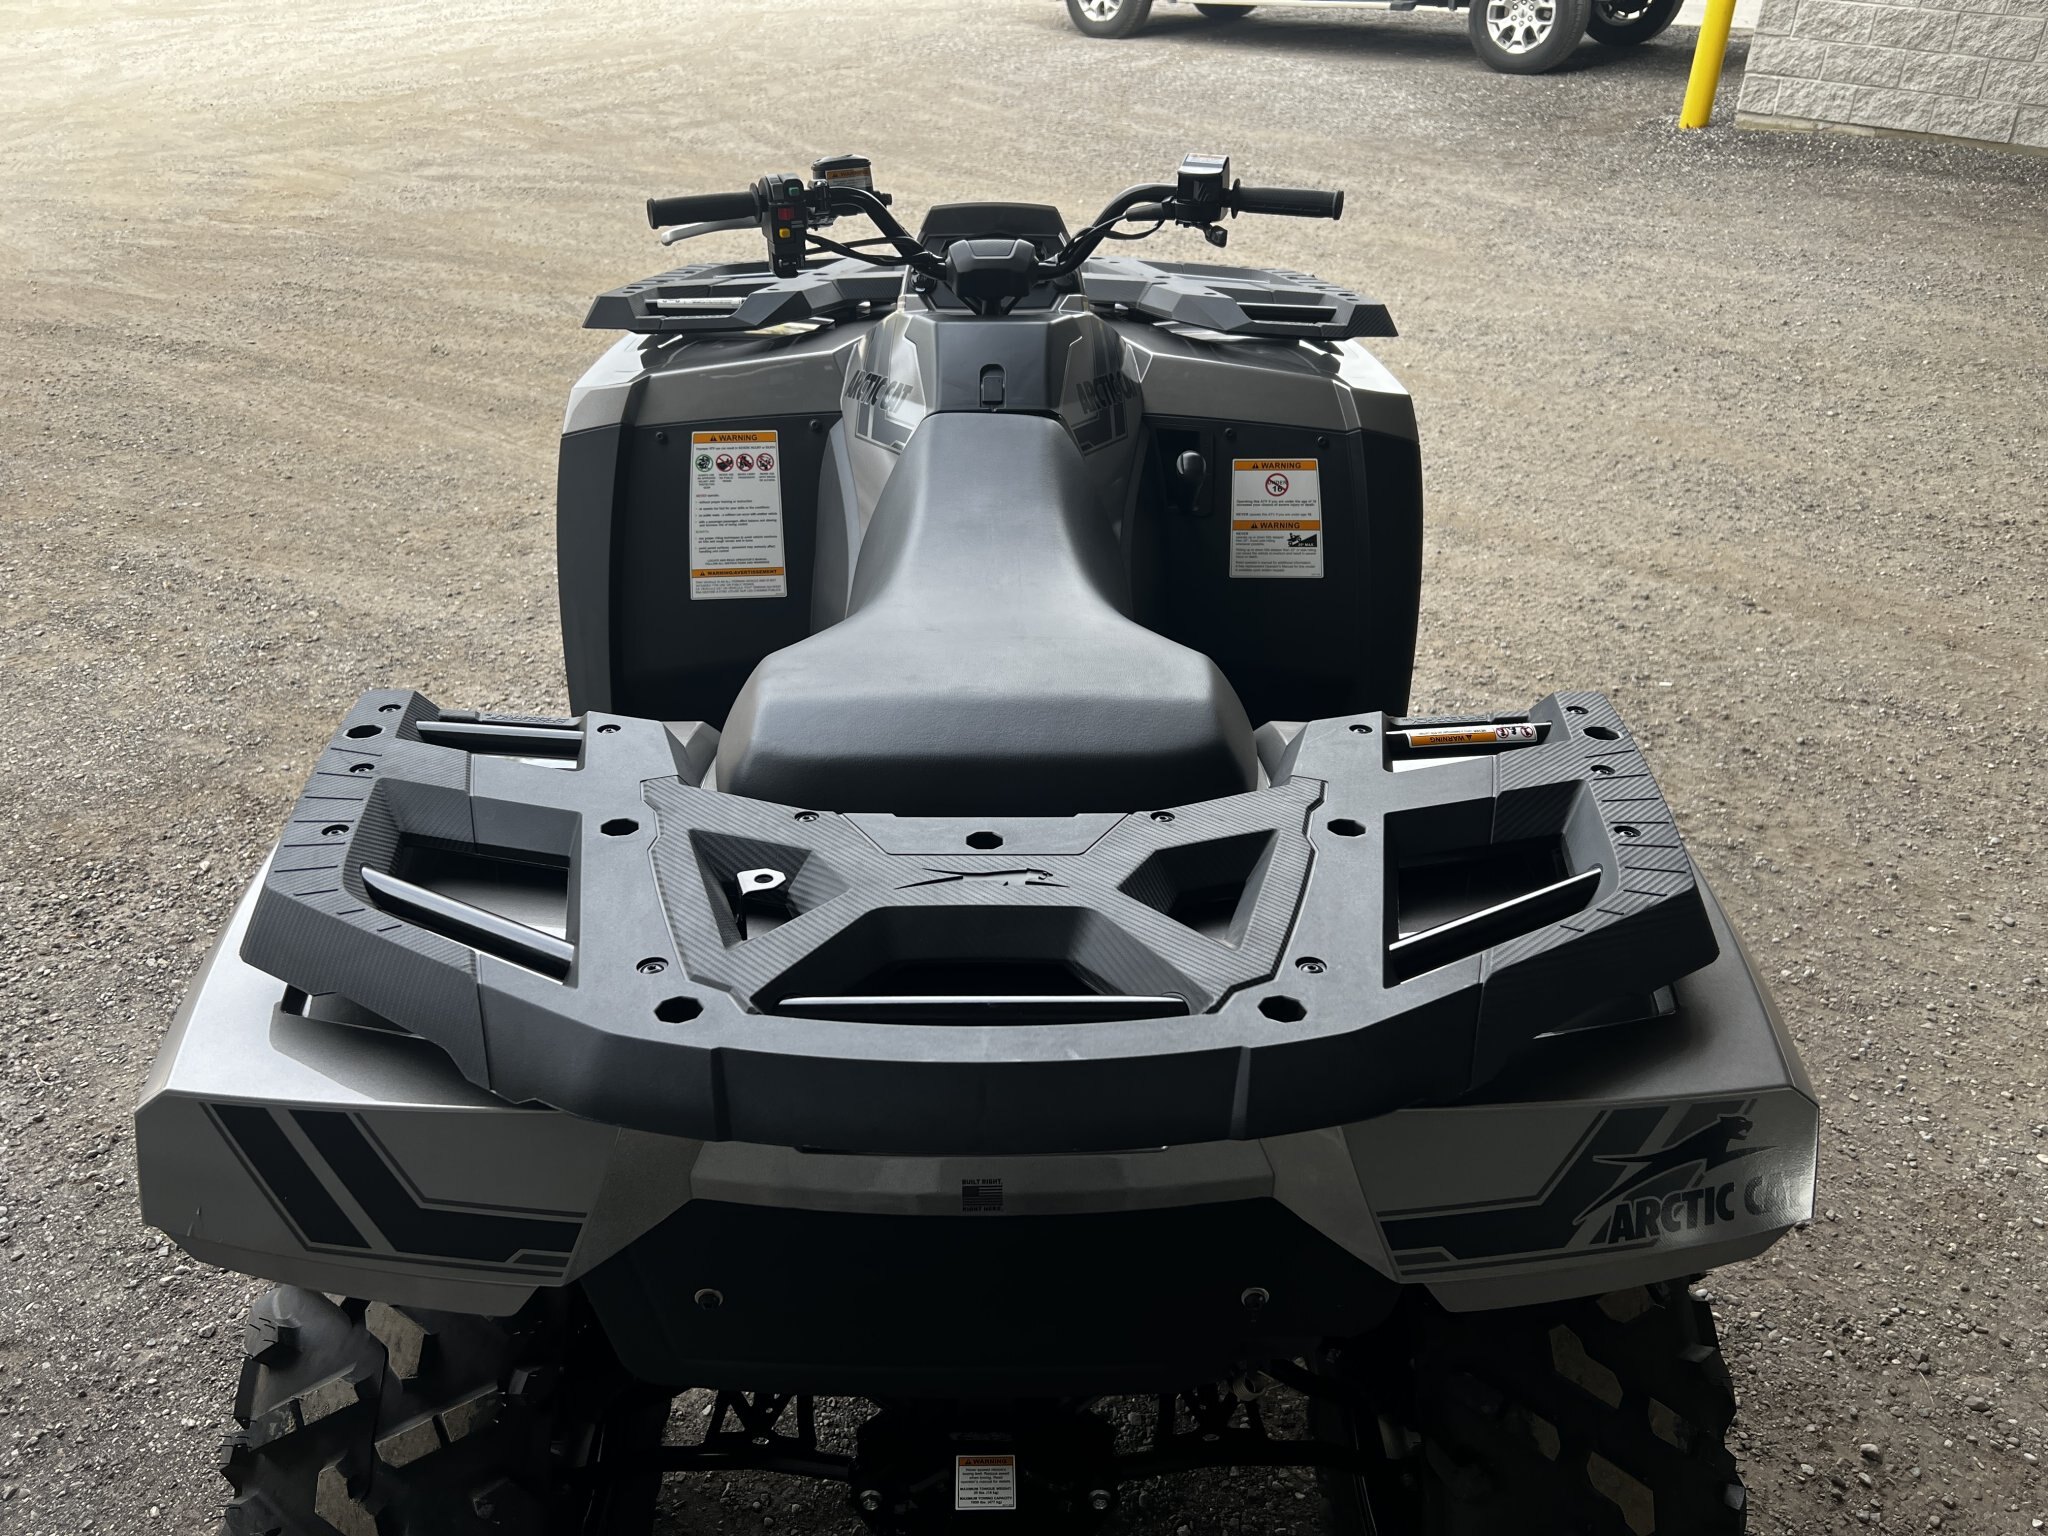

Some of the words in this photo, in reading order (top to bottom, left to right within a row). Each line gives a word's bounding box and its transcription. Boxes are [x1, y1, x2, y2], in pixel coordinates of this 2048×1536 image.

[845, 370, 888, 406] ARCTIC
[880, 380, 914, 414] CAT
[1430, 735, 1465, 743] WARNING
[1608, 1182, 1734, 1244] ARCTIC
